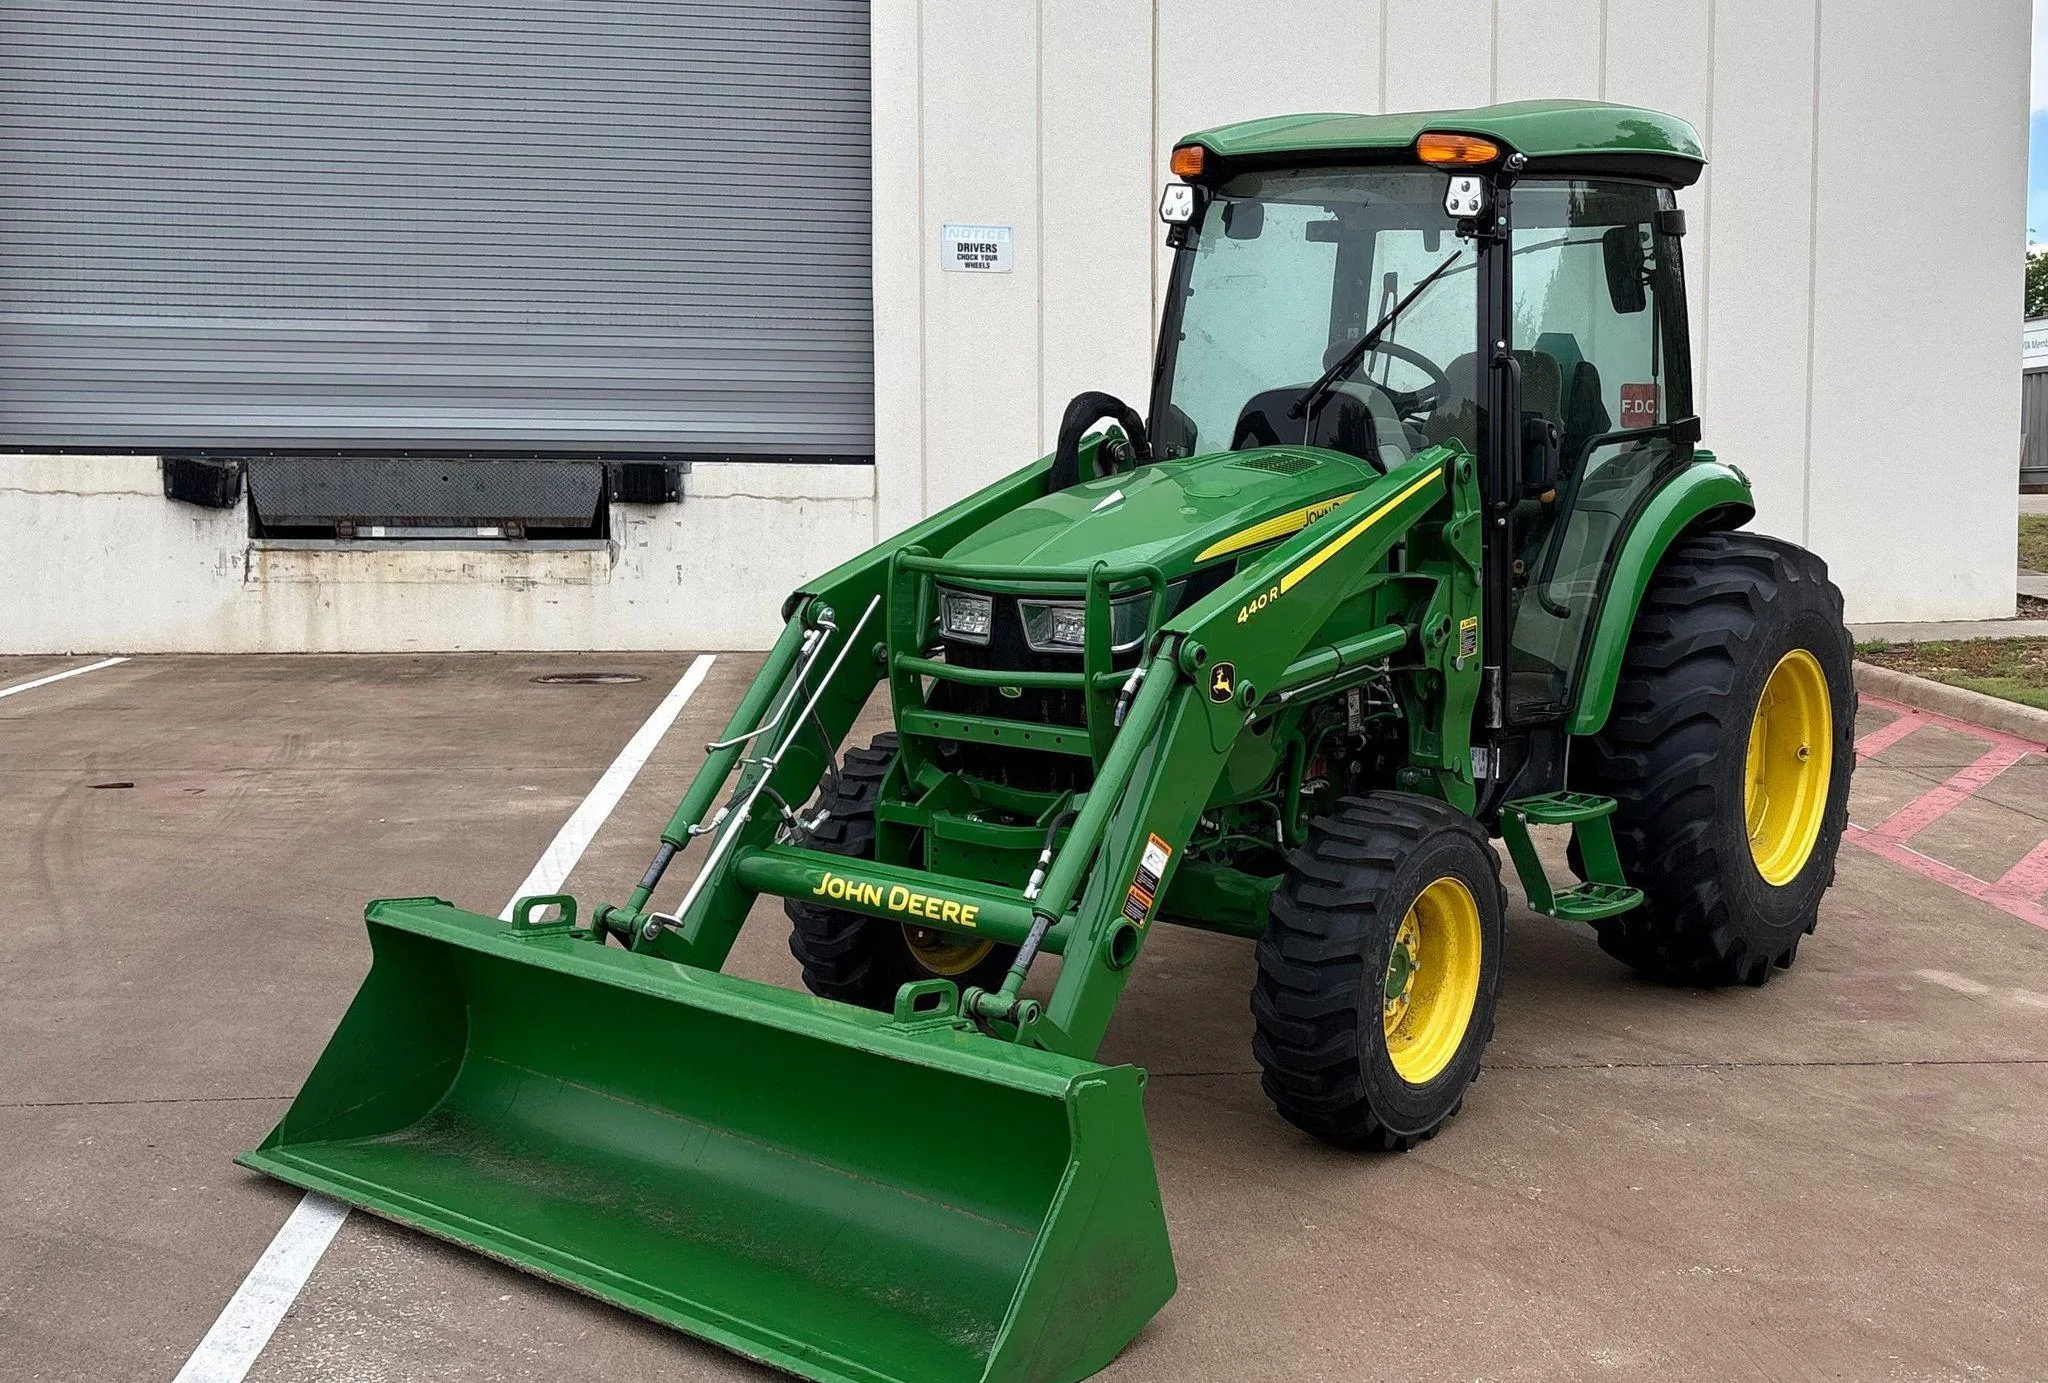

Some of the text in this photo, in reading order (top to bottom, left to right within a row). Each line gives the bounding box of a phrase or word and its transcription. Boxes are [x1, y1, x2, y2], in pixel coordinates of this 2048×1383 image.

[947, 228, 1008, 240] NOTICE
[957, 242, 998, 253] DRIVERS
[956, 253, 979, 261] CHOCK
[964, 261, 991, 269] WHEELS
[1237, 586, 1278, 624] 440 R
[812, 872, 980, 928] JOHN DEERE
